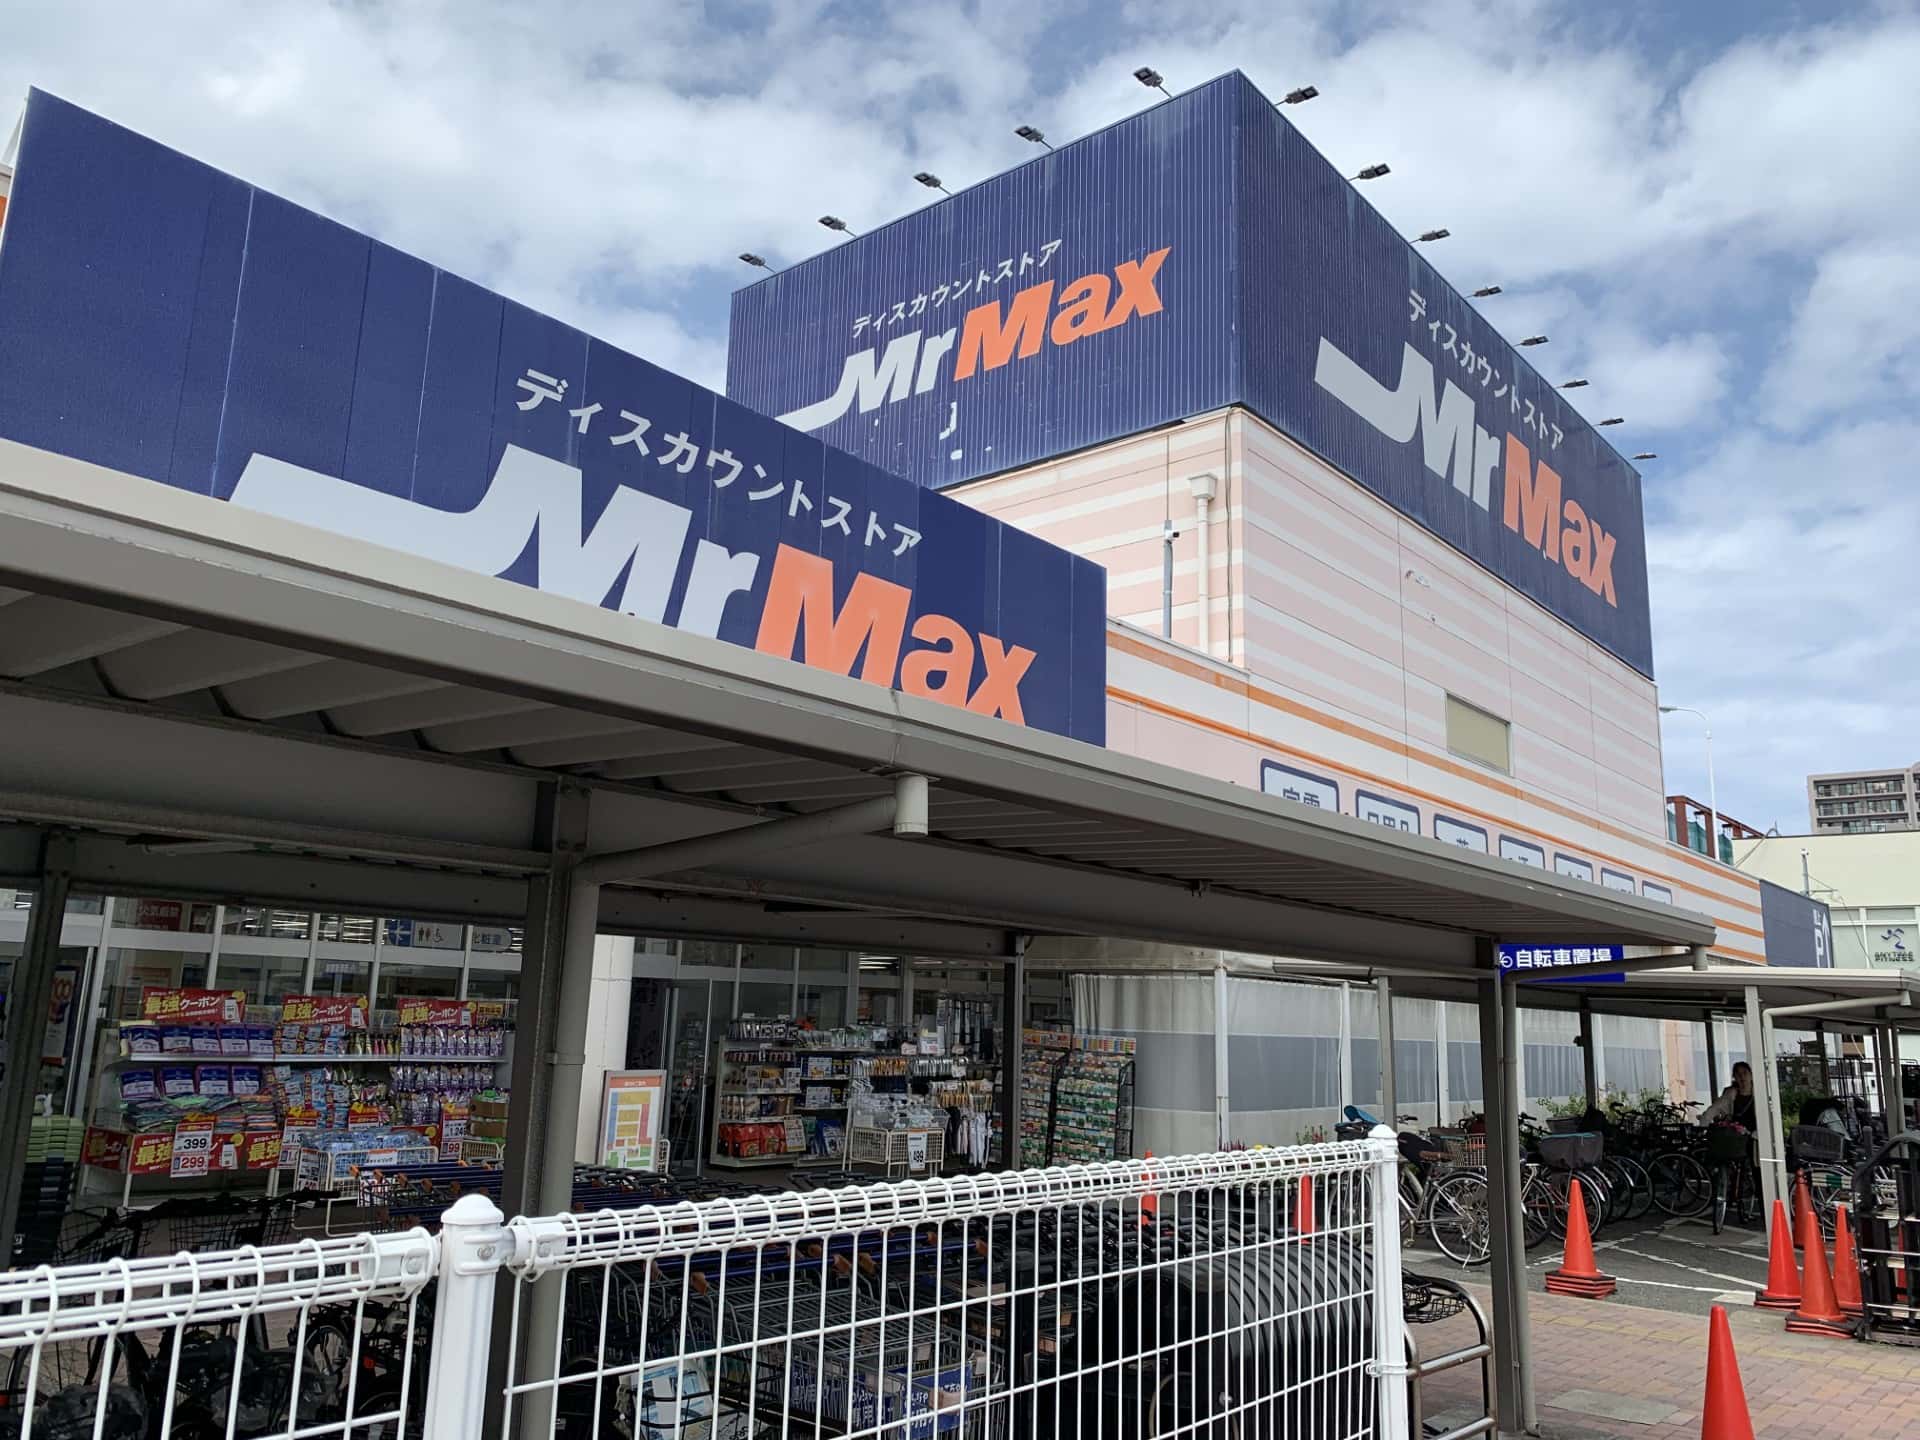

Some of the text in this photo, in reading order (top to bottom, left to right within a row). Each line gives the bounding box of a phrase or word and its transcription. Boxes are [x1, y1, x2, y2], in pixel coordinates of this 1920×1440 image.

[774, 246, 1173, 434] MrMax
[852, 239, 1063, 339] ディスカウントストア
[1408, 288, 1564, 450] ディスカウントストア
[515, 368, 924, 558] ディスカウントストア
[1313, 335, 1618, 609] MrMax
[229, 443, 1038, 728] MrMax
[1515, 947, 1612, 969] 自転車置場
[181, 1156, 205, 1169] 299
[183, 1137, 208, 1150] 399
